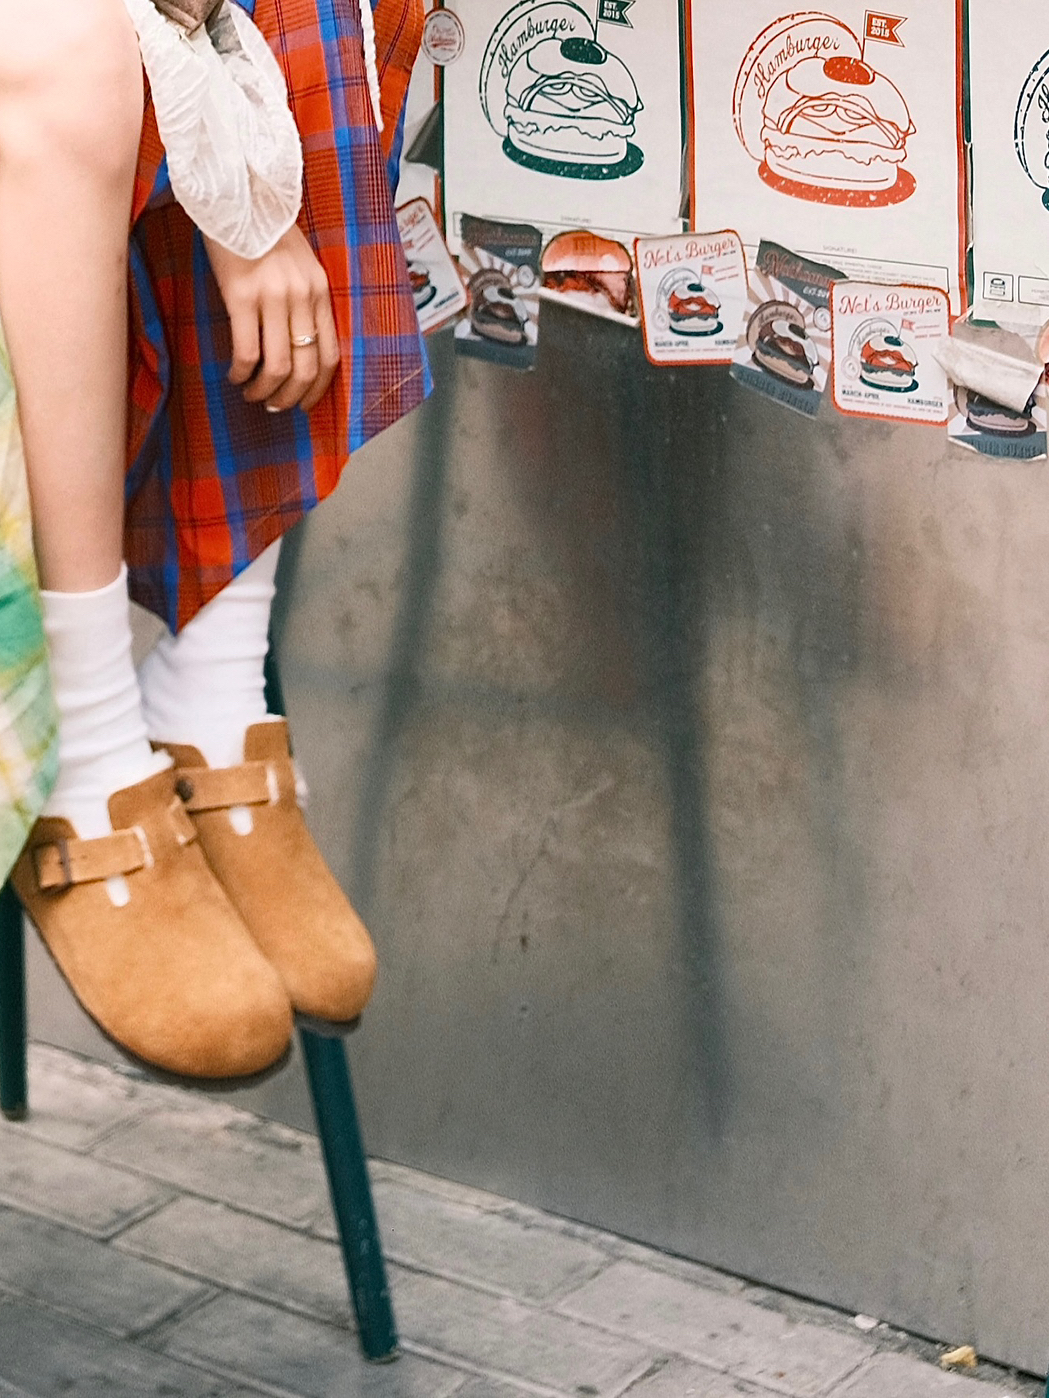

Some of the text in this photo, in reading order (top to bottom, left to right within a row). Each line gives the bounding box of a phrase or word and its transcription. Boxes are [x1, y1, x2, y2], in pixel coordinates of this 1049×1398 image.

[498, 15, 577, 79] Hamburger
[753, 32, 841, 100] Hamburger
[685, 238, 736, 259] Burger
[885, 292, 942, 315] Burger
